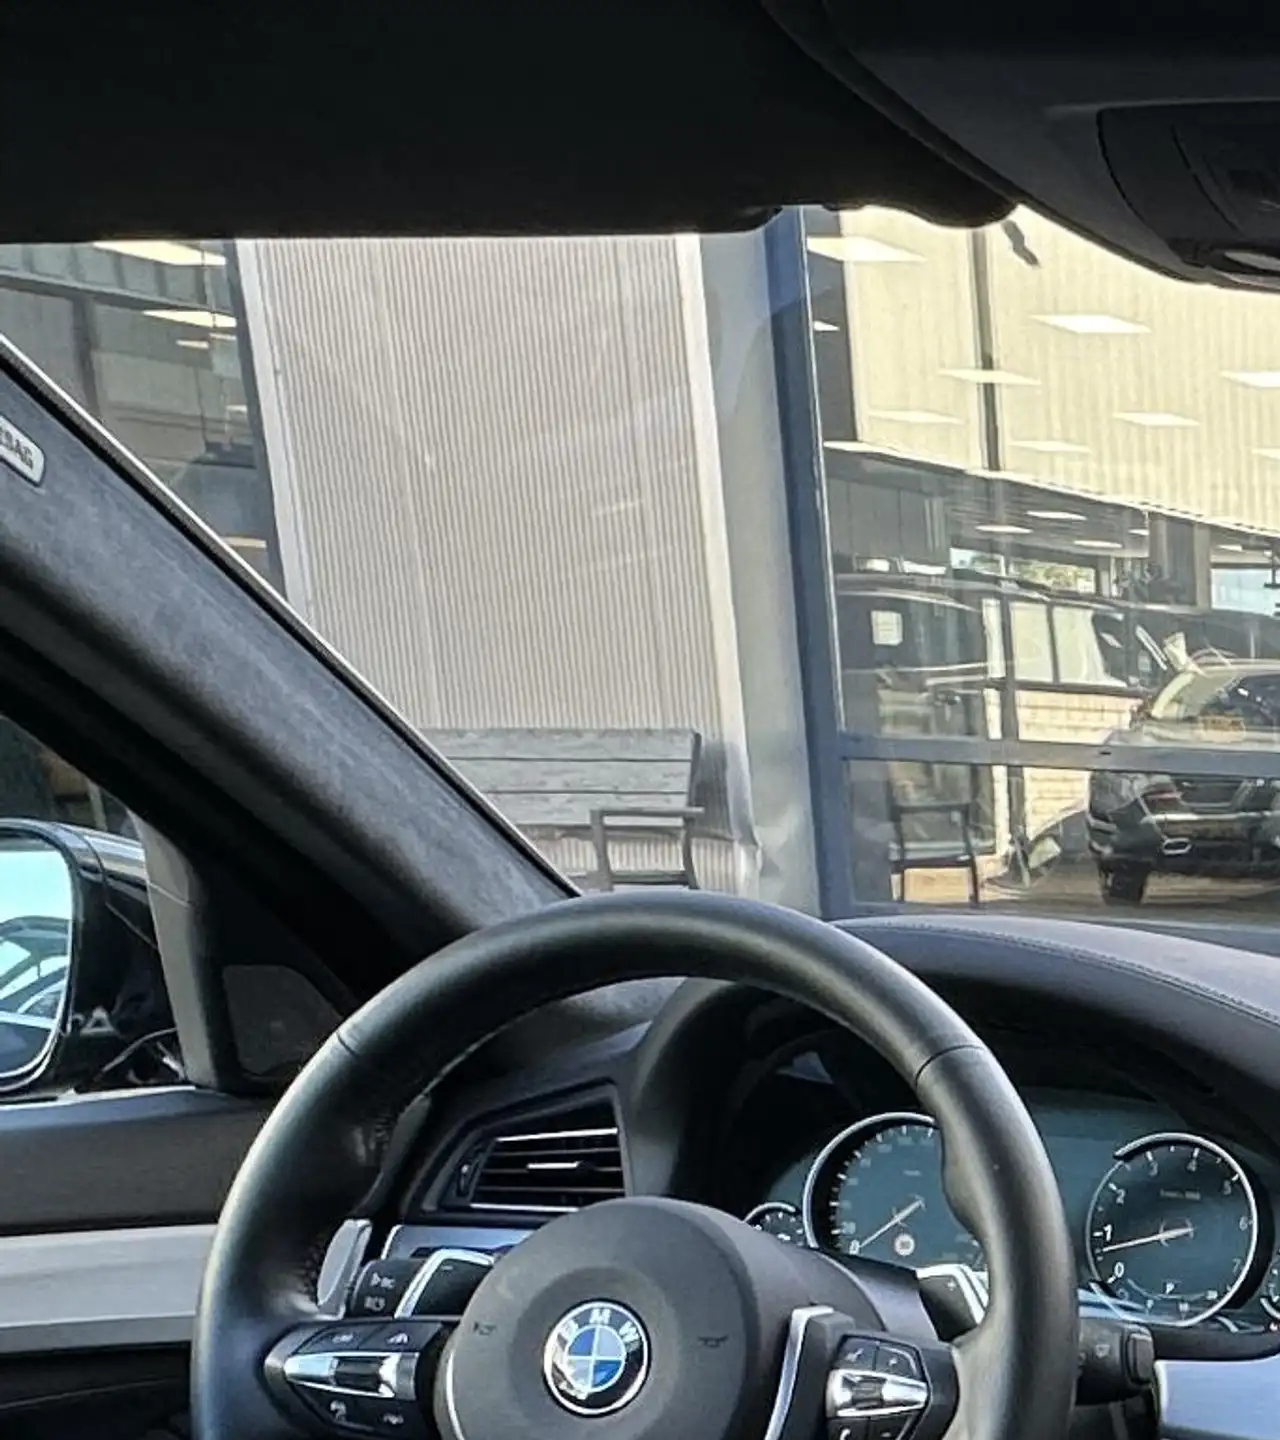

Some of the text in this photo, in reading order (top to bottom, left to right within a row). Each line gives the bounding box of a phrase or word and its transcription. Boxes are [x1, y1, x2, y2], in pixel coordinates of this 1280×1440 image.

[1116, 1189, 1126, 1204] 2
[1114, 1261, 1125, 1278] 0
[558, 1307, 641, 1346] BMW
